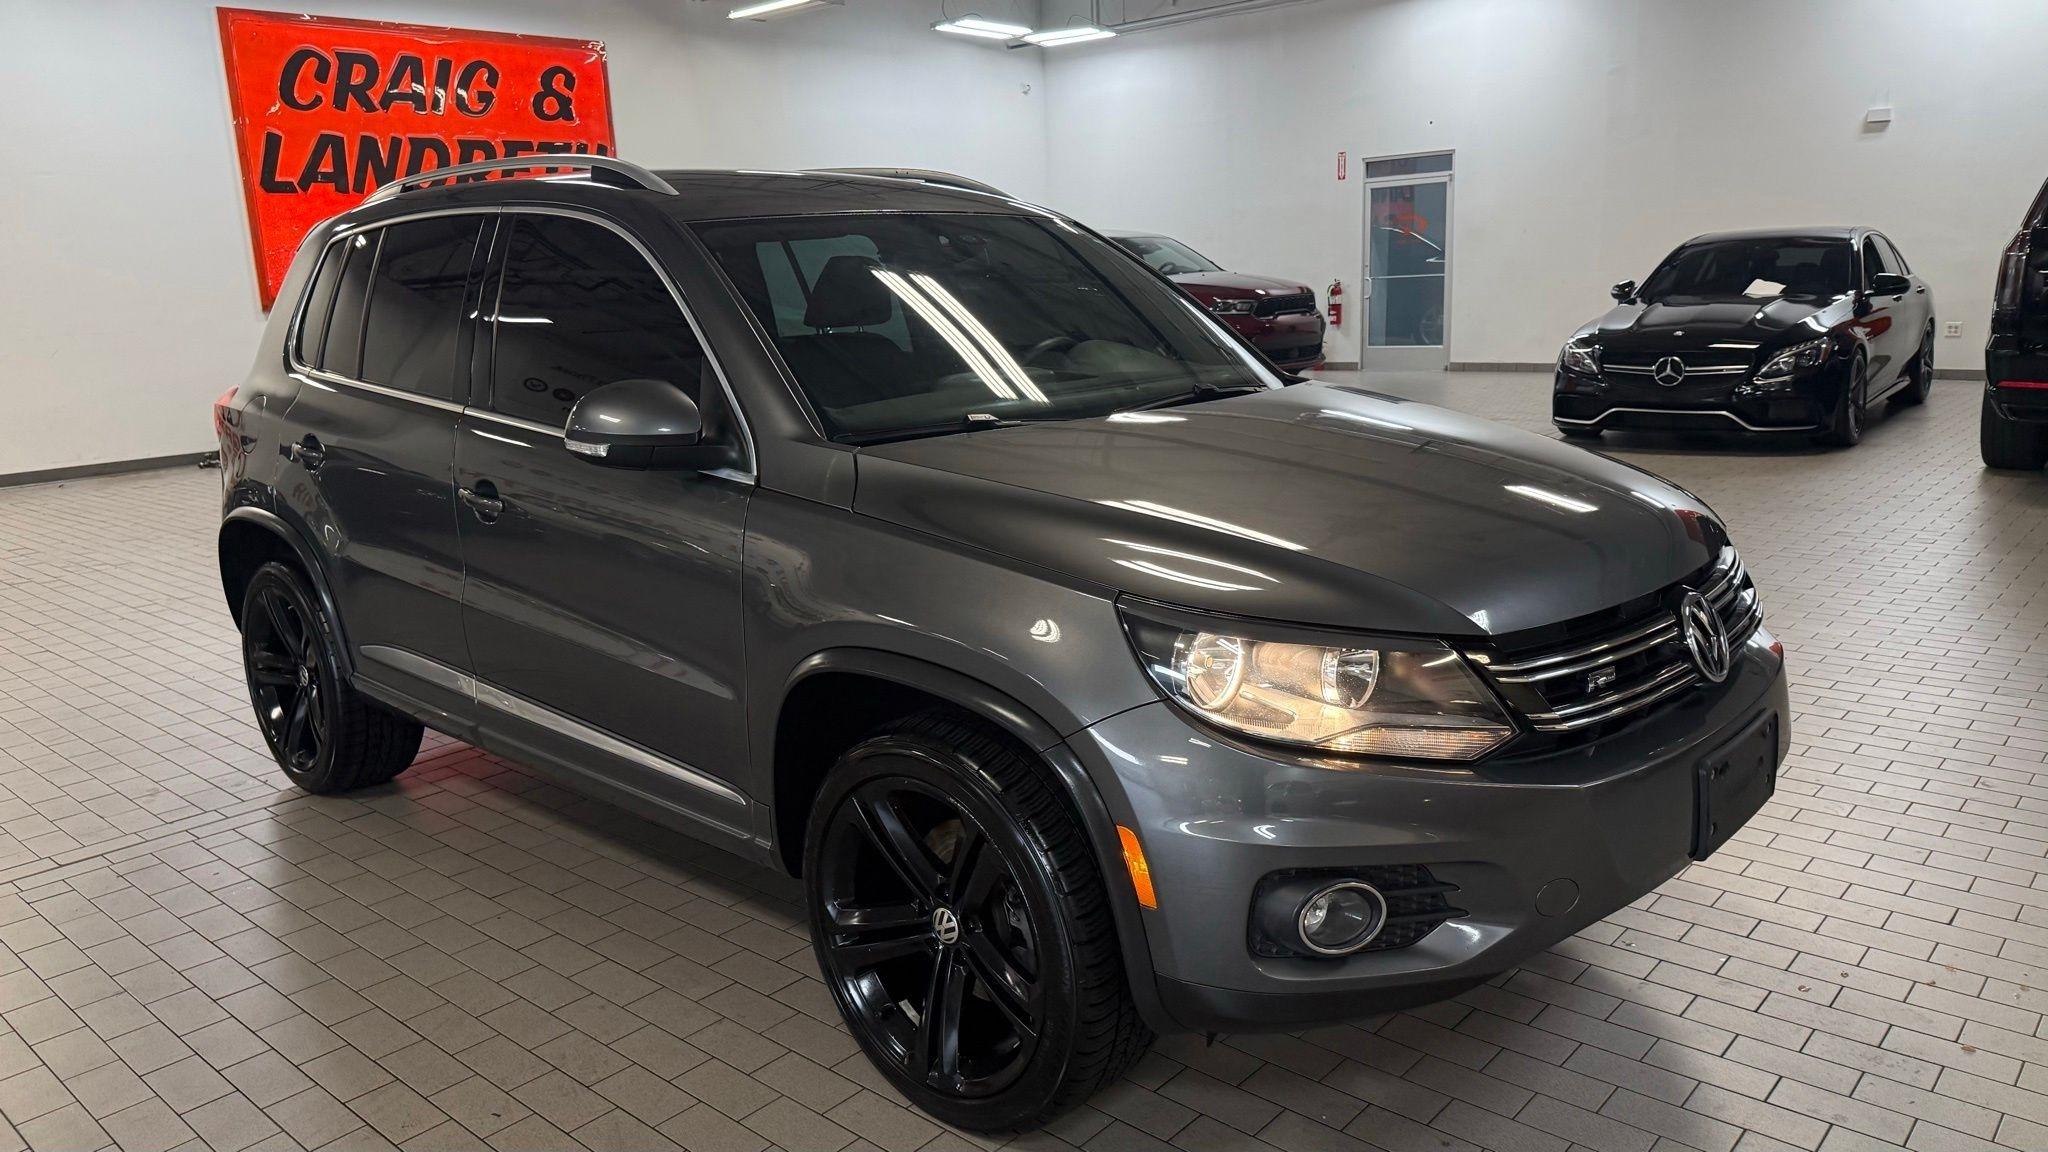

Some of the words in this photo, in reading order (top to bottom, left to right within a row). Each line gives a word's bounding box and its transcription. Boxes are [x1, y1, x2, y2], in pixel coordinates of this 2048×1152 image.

[279, 48, 501, 117] CRAIG
[532, 65, 577, 121] &
[261, 131, 608, 194] LANDRET
